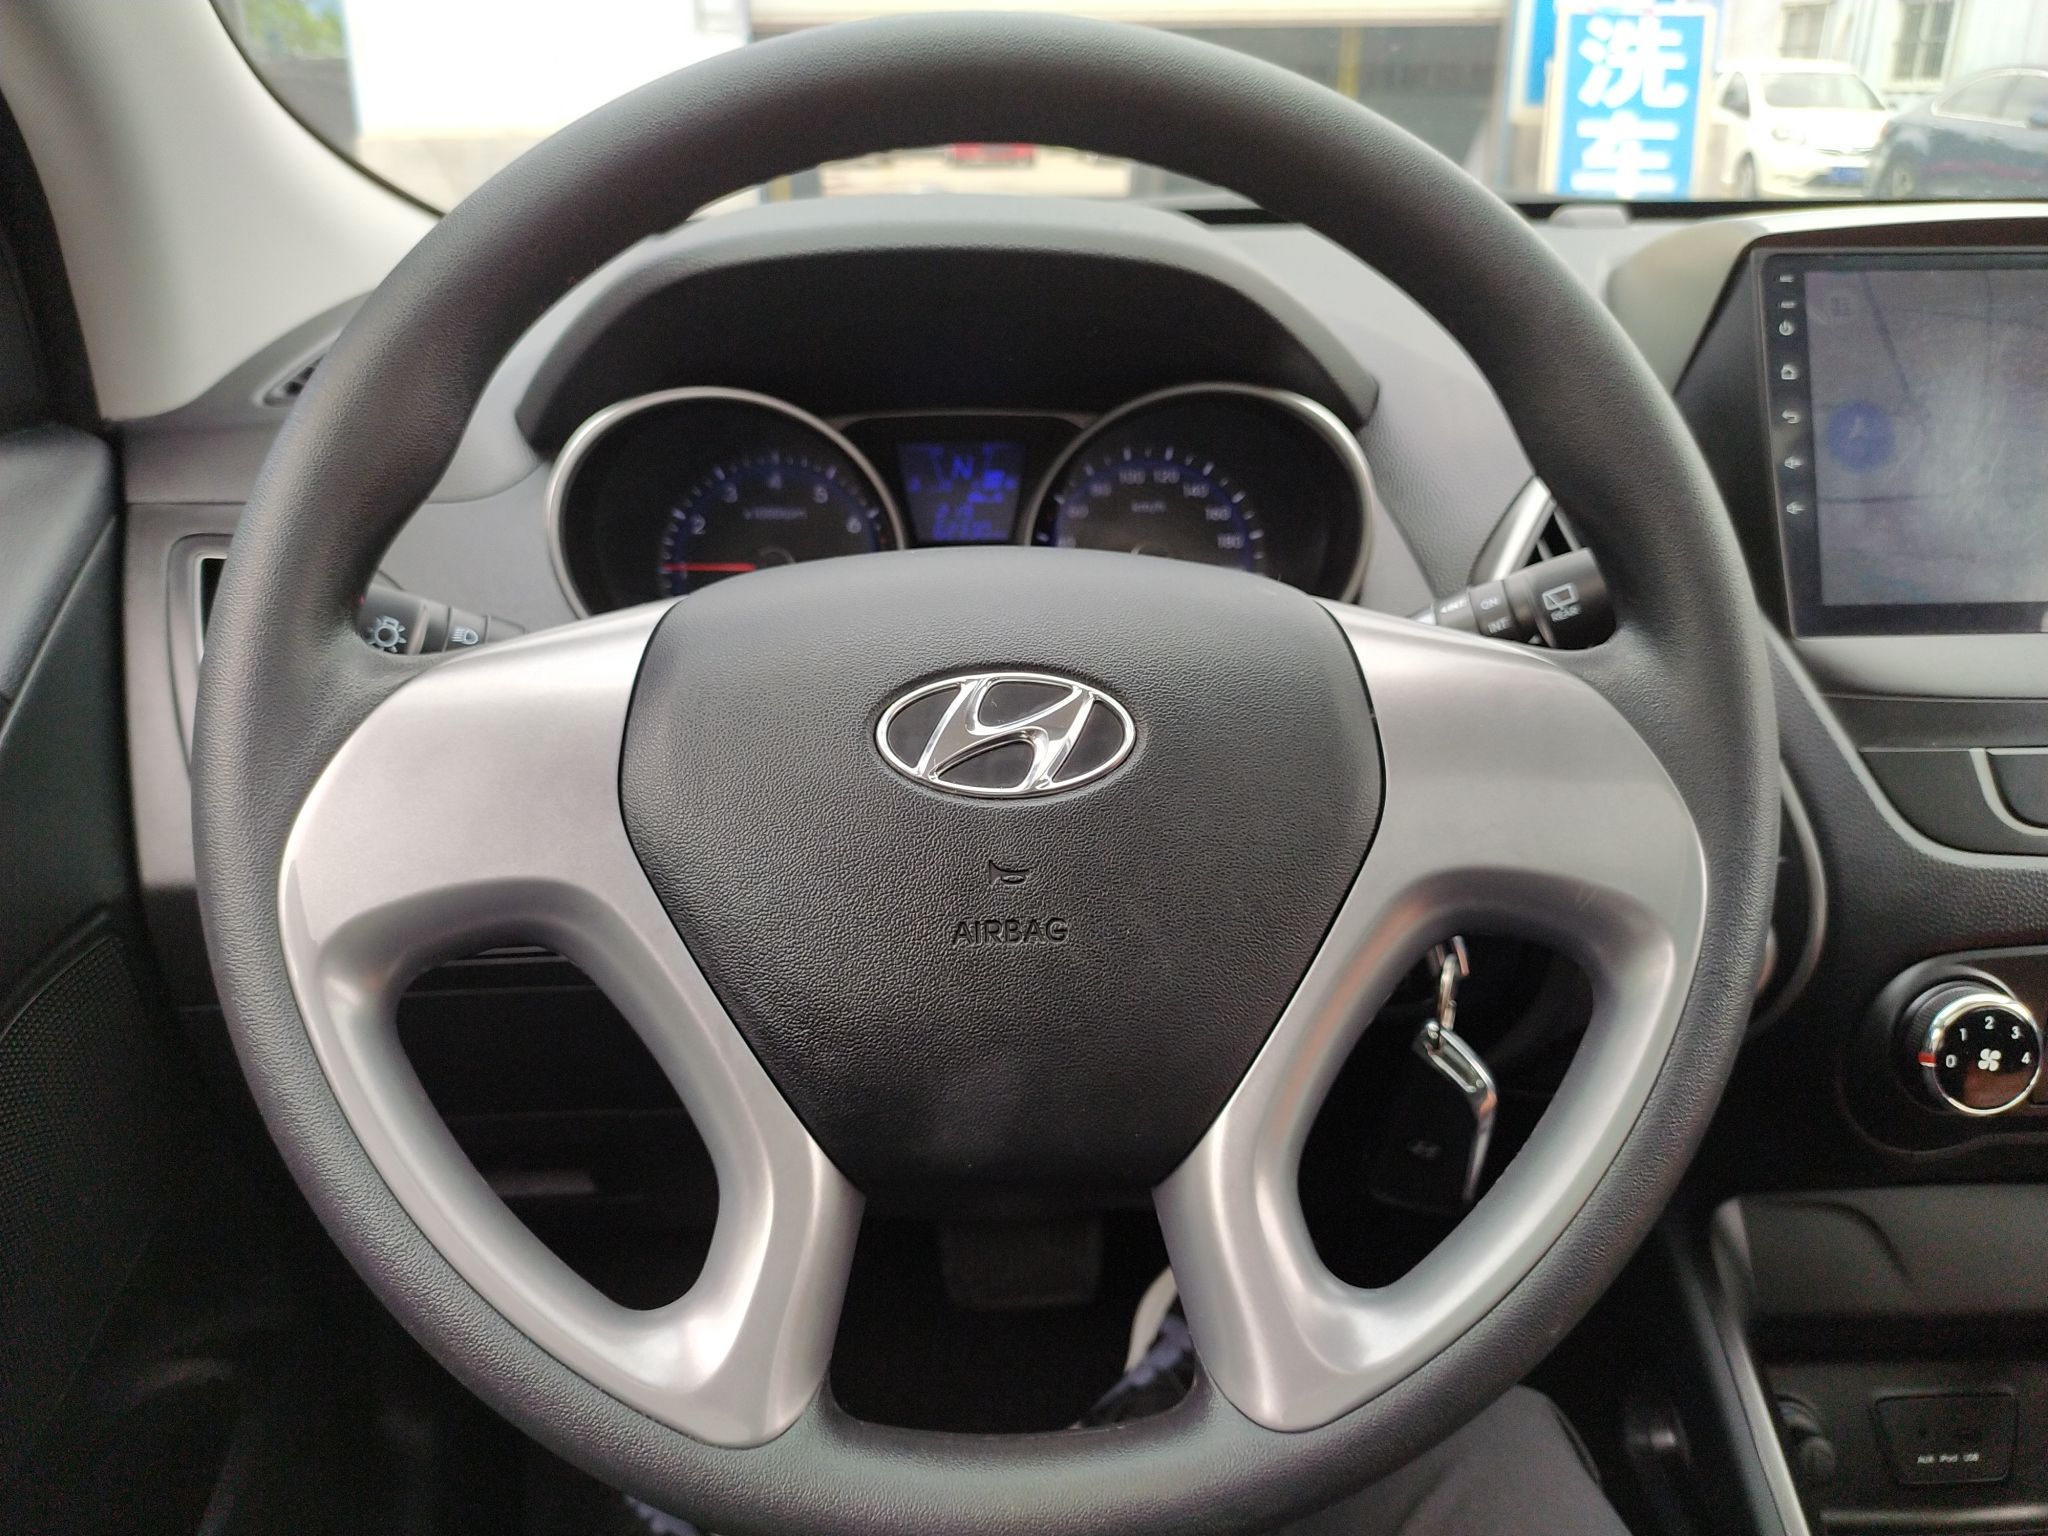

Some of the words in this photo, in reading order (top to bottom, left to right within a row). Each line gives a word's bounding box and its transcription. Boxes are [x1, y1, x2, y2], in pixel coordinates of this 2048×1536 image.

[1570, 16, 1689, 198] 洗车
[690, 515, 706, 535] 2
[846, 516, 862, 534] 6
[953, 917, 1069, 944] AIRBAG
[1984, 1016, 1995, 1029] 2
[1959, 1028, 1967, 1041] 1
[2011, 1026, 2022, 1039] 3
[1945, 1054, 1957, 1068] 0
[2021, 1052, 2031, 1065] 4
